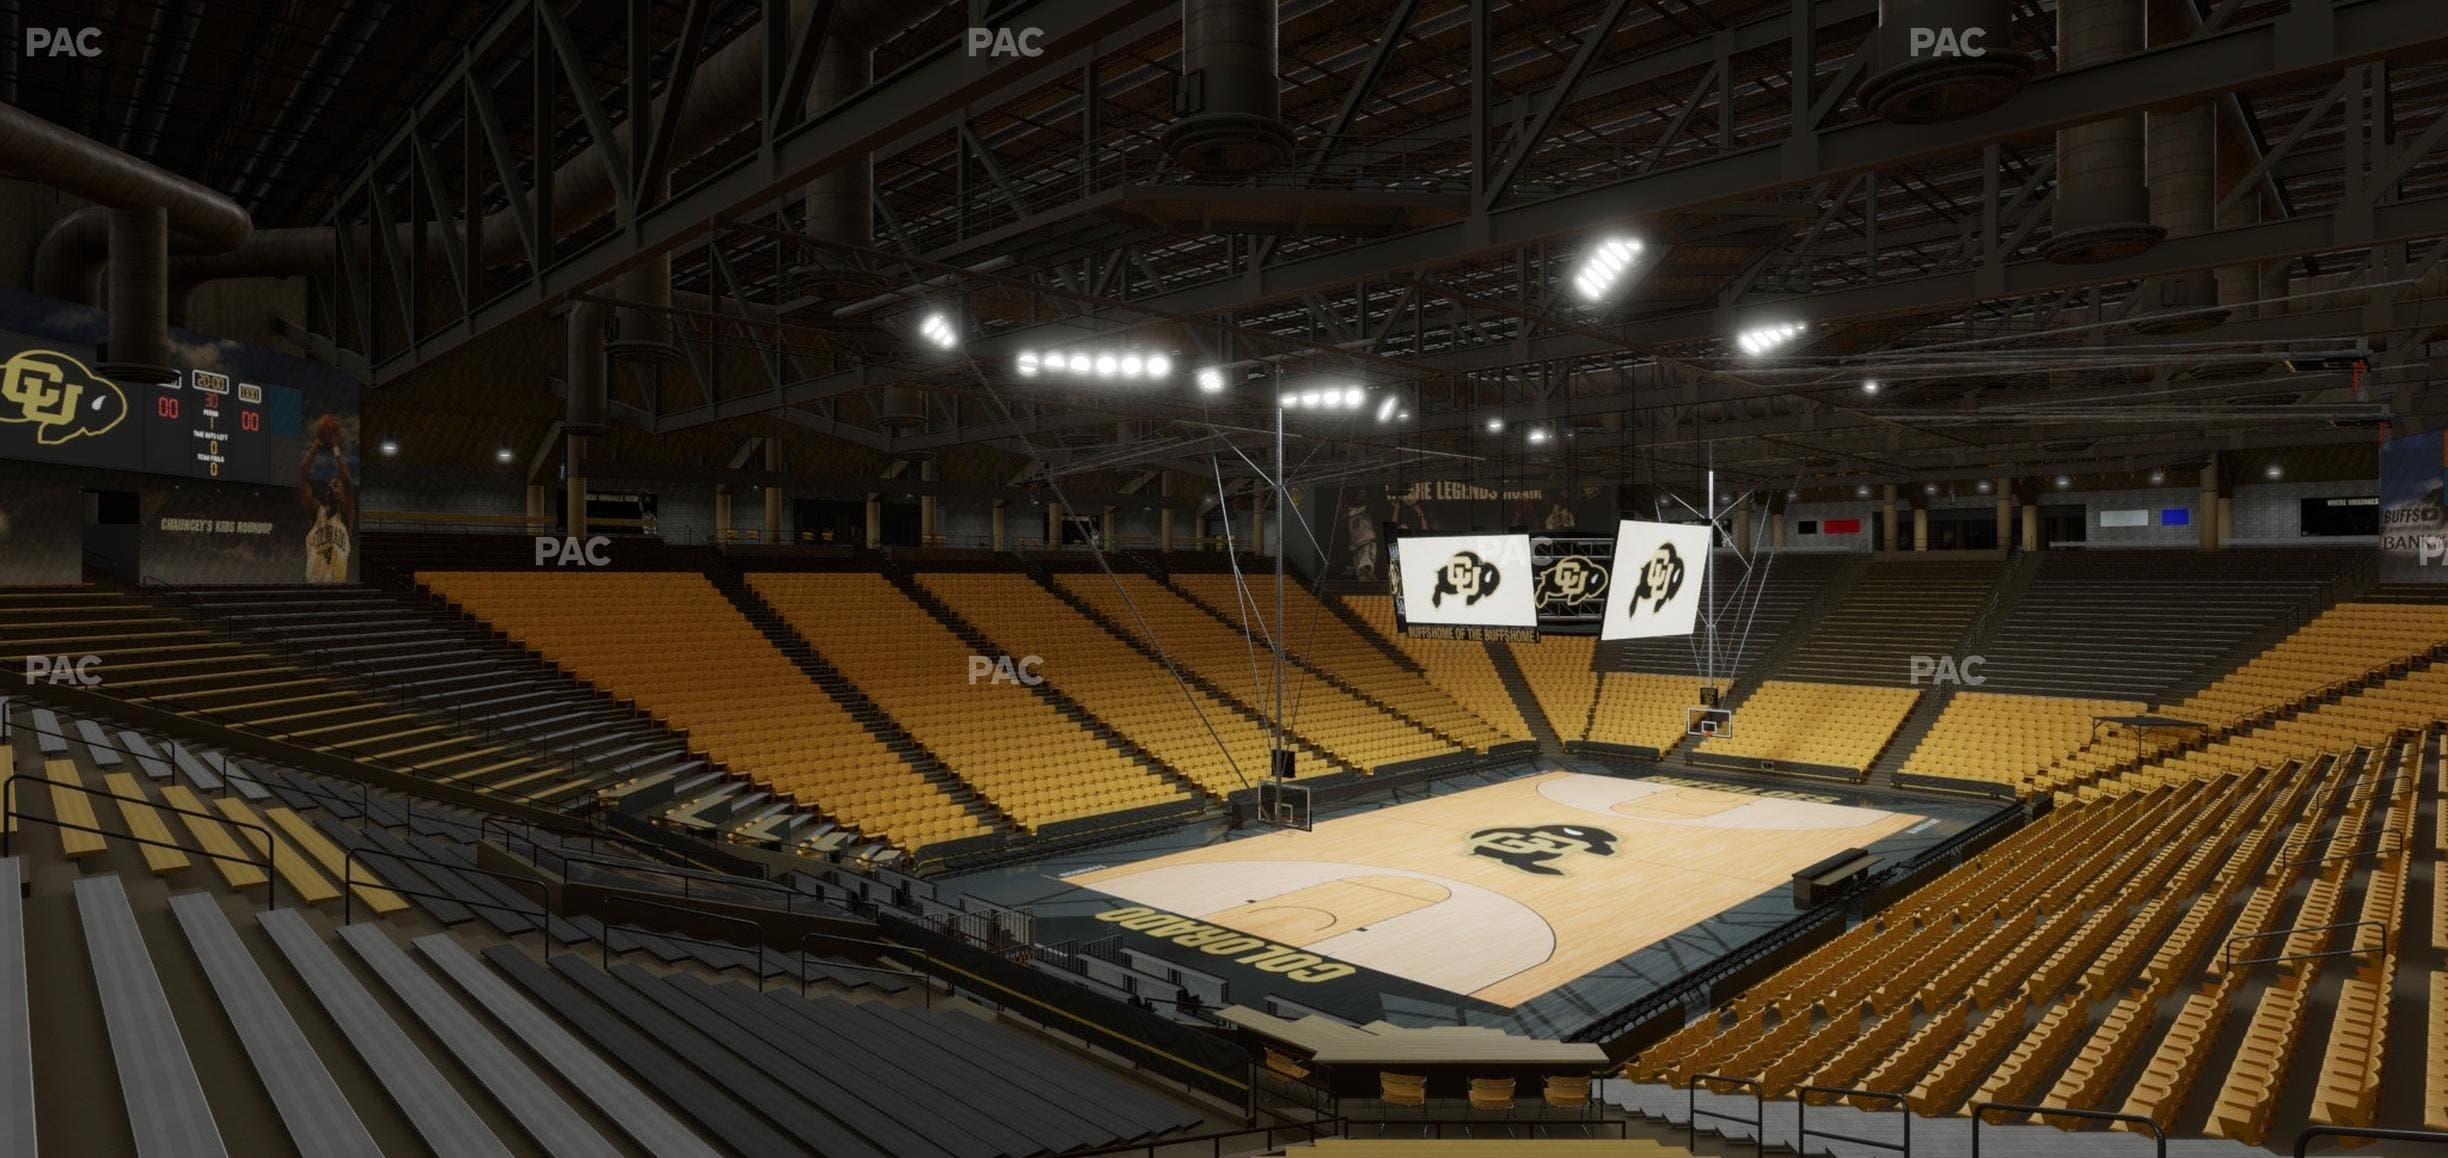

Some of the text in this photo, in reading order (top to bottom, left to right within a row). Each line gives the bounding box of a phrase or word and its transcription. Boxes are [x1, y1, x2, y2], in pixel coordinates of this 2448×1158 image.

[2, 358, 83, 425] CU
[158, 396, 179, 419] 00
[241, 411, 260, 431] 00
[1437, 481, 1498, 501] LEGENDS
[161, 517, 274, 535] CHAUNCEY'S KIDS ROUNDUP
[2384, 508, 2420, 524] BUFFS
[1455, 627, 1466, 640] OF
[1467, 626, 1484, 641] THE
[1095, 907, 1356, 982] COLORADO
